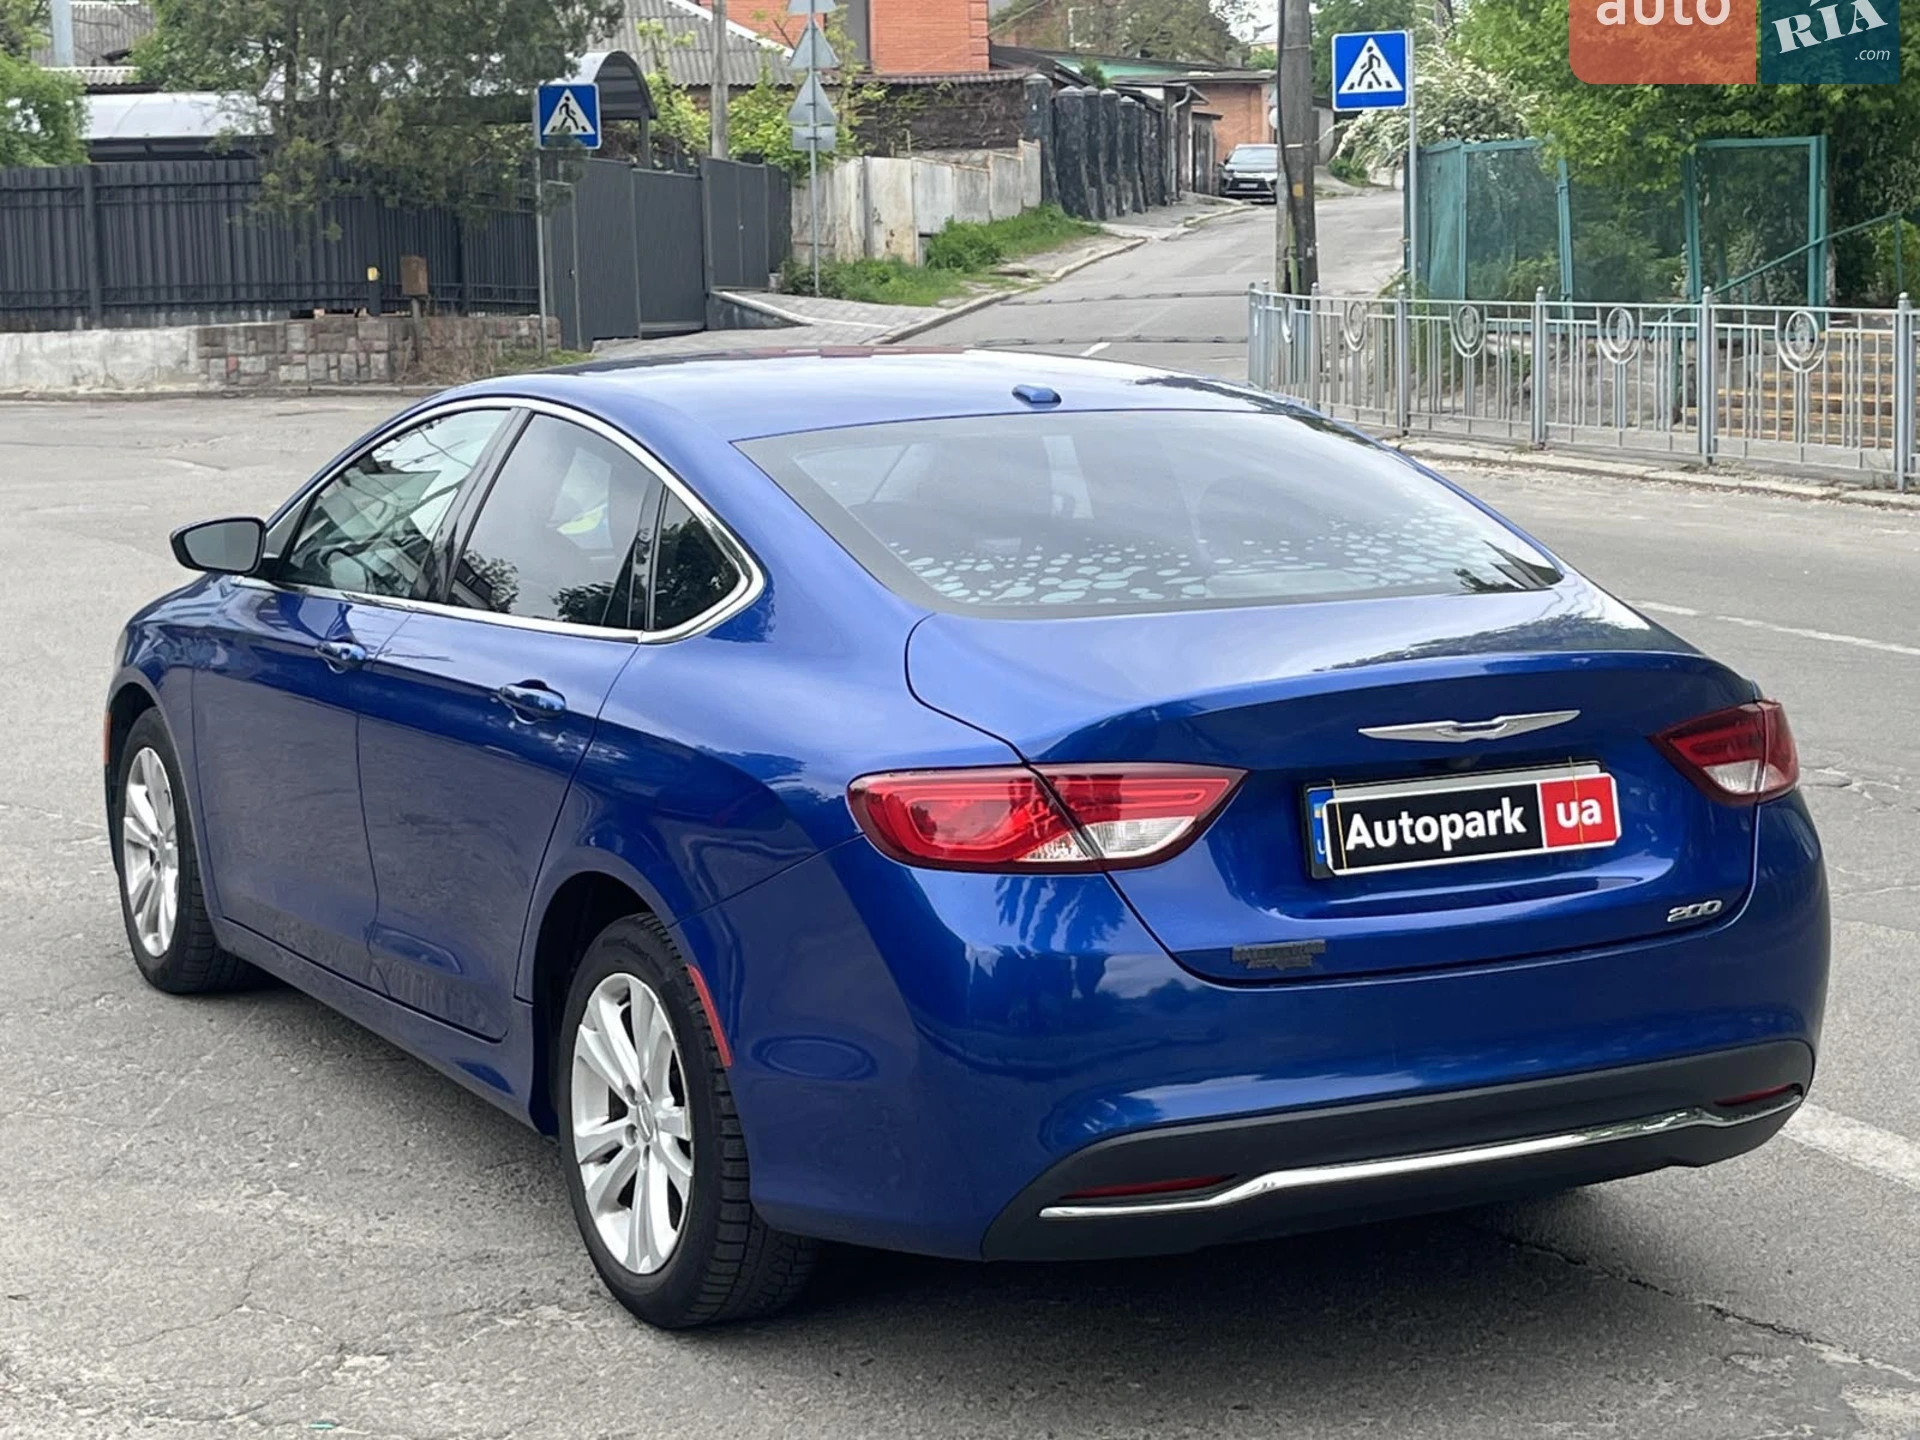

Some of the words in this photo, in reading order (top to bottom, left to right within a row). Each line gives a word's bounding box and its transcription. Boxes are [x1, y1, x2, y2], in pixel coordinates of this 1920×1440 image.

[1345, 797, 1527, 851] Autopark
[1555, 798, 1602, 828] ua
[1667, 900, 1722, 922] 200
